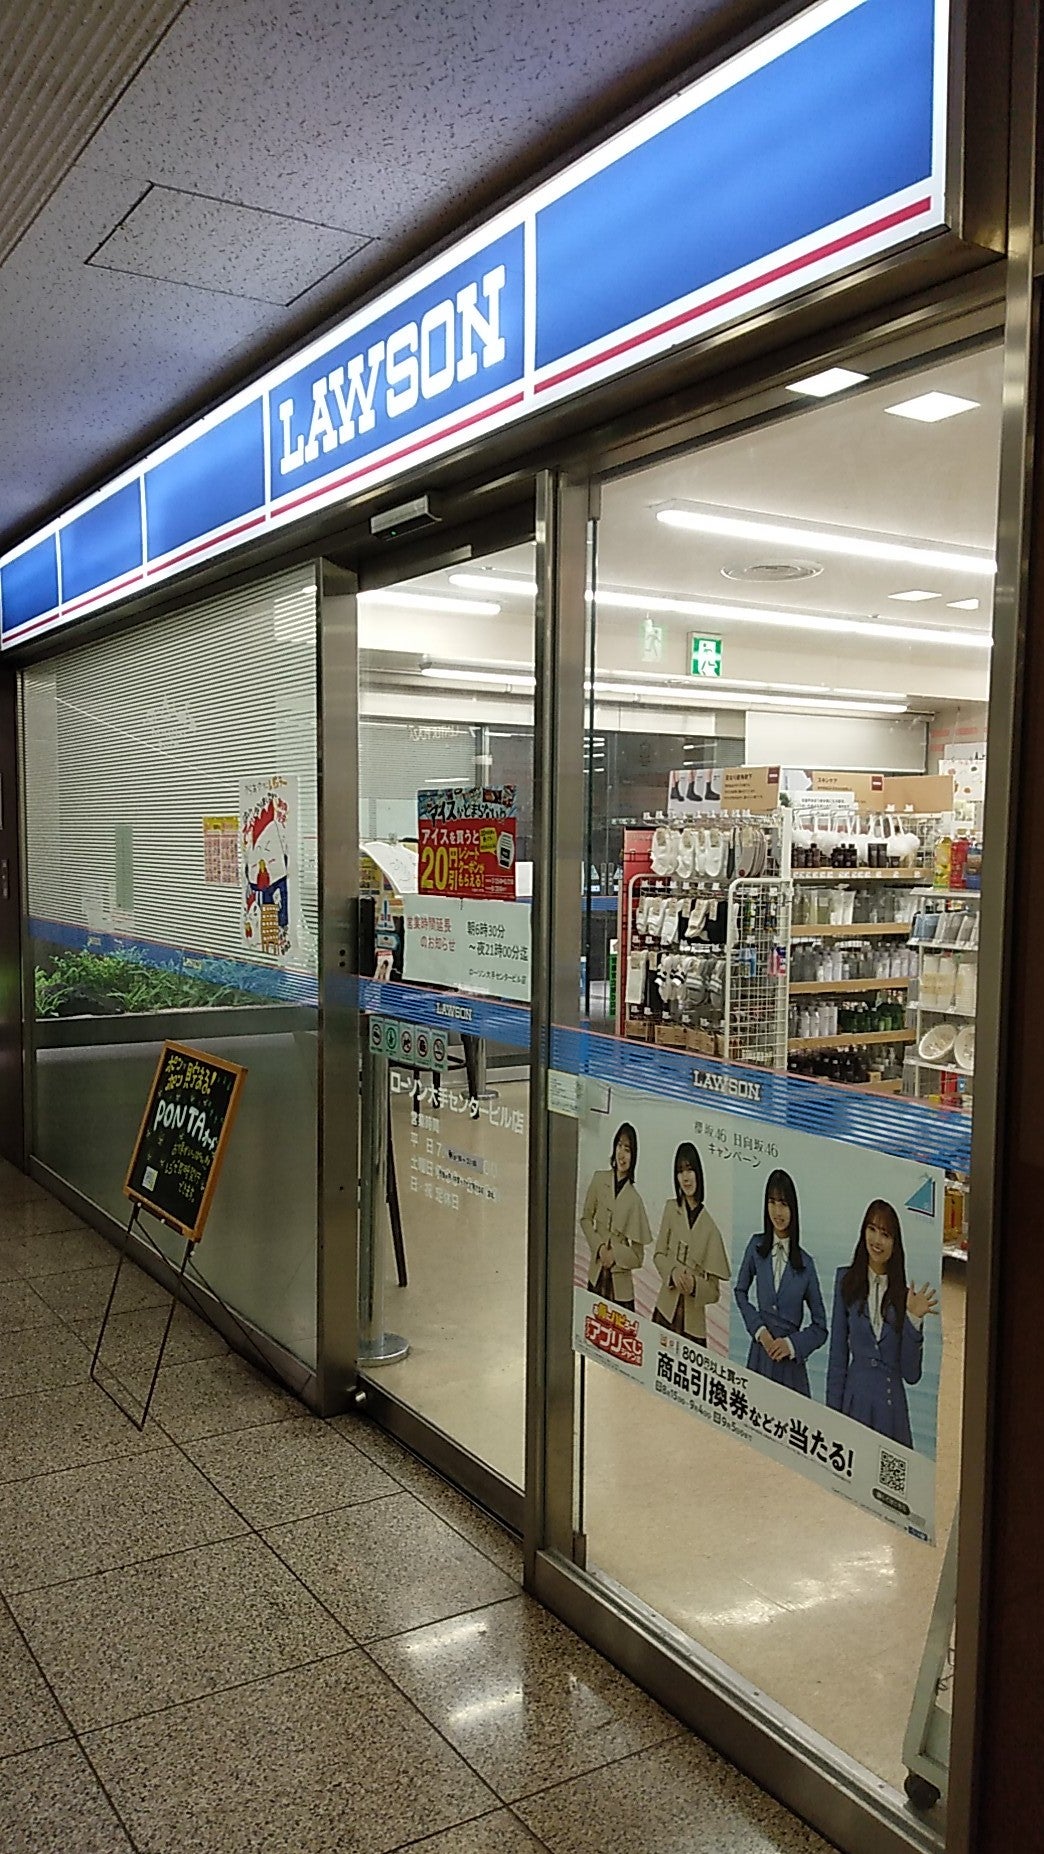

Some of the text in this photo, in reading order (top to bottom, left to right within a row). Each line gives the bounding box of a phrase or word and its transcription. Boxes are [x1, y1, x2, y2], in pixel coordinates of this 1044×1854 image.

[278, 264, 505, 476] LAWSON
[421, 828, 480, 845] アイスを買うと
[421, 846, 449, 890] 20
[466, 921, 506, 939] 朝6時30分
[420, 935, 456, 952] のお知らせ
[436, 1002, 472, 1020] LAWSON
[691, 1068, 762, 1102] LAWSON
[707, 1143, 762, 1169] キャンペーン
[733, 1132, 780, 1159] 日向坂46
[589, 1319, 643, 1356] アプリくじ
